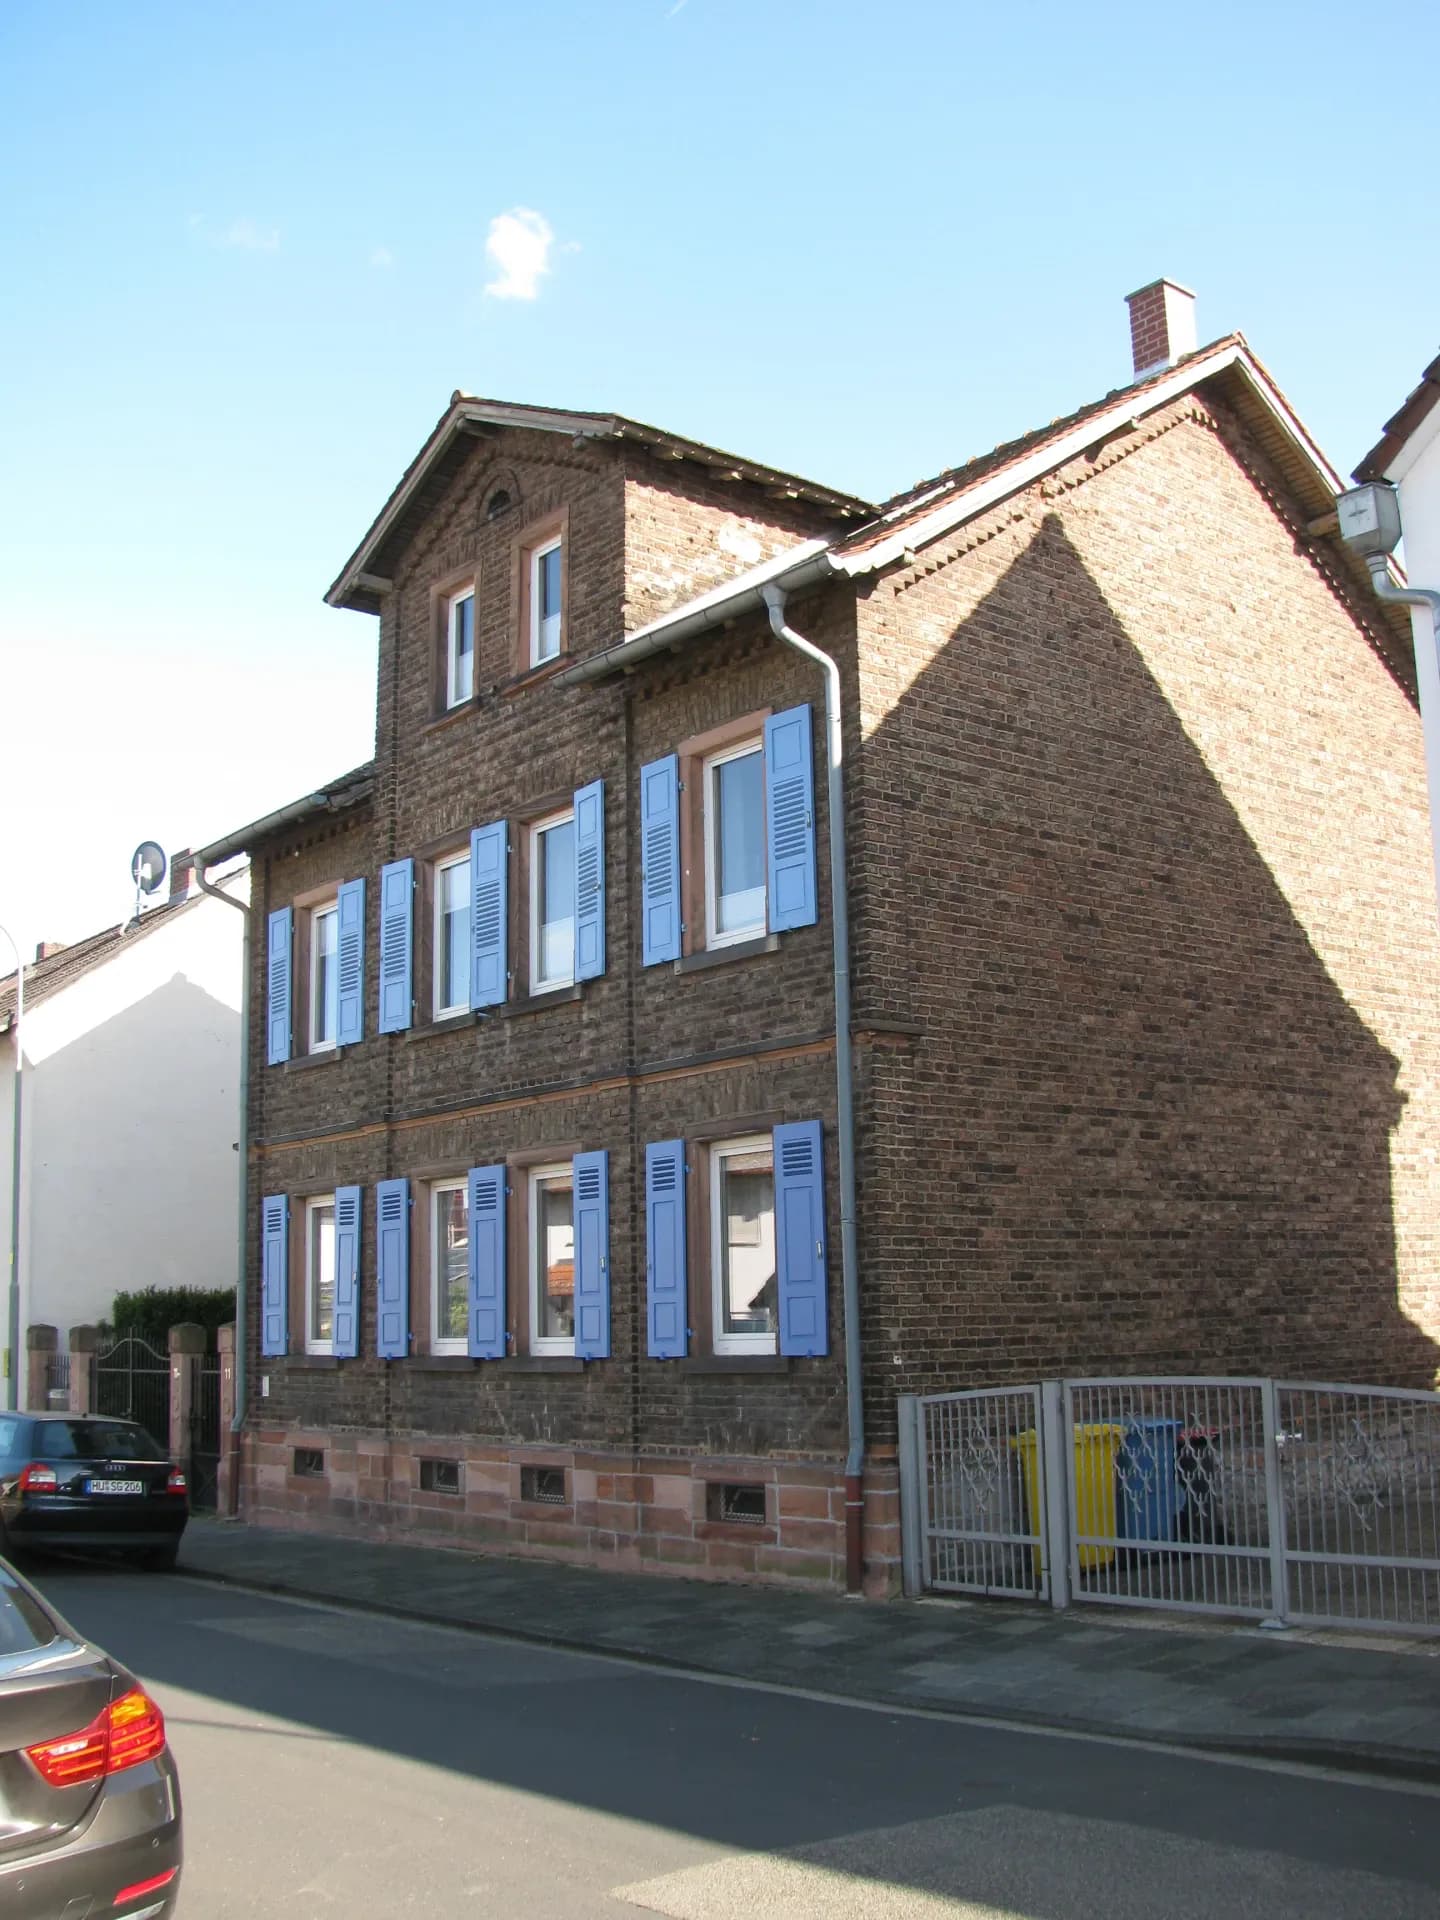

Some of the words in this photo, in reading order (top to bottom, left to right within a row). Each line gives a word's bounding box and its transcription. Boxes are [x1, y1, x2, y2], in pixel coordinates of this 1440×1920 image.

[92, 1481, 105, 1491] HU
[110, 1481, 123, 1491] SG
[124, 1482, 141, 1492] 206
